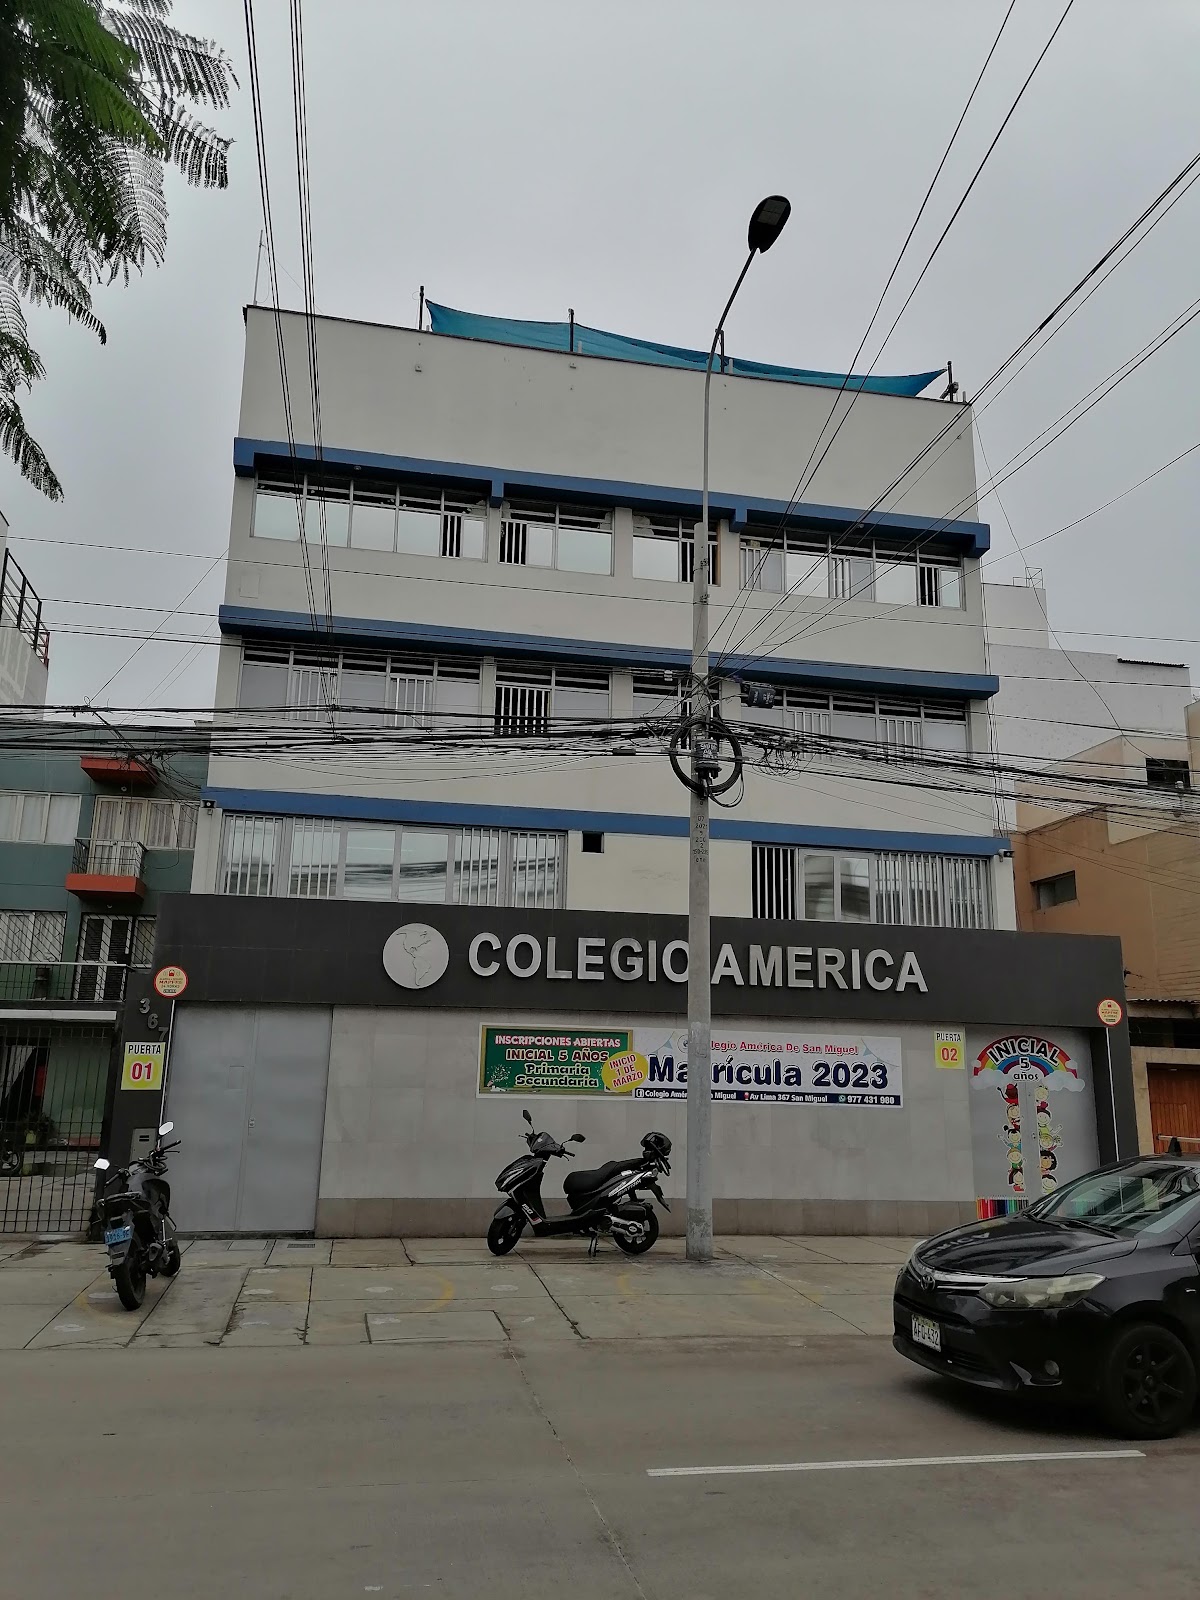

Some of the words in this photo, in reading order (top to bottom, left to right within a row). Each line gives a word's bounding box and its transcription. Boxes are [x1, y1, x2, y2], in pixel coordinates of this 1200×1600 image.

[468, 932, 690, 983] COLEGIO
[710, 943, 929, 992] AMERICA
[495, 1035, 572, 1046] INSCRIPCIONES
[573, 1036, 621, 1047] ABIERTAS
[937, 1033, 961, 1042] PUERTA
[128, 1044, 161, 1054] PUERTA
[711, 1041, 738, 1052] legio
[740, 1041, 783, 1053] América
[786, 1043, 800, 1053] De
[803, 1044, 822, 1054] San
[825, 1044, 859, 1056] Miguel
[941, 1048, 958, 1061] 02
[987, 1038, 1060, 1064] INICIAL
[506, 1049, 554, 1061] INICIAL
[558, 1050, 568, 1061] 5
[572, 1048, 609, 1062] AÑOS
[609, 1054, 636, 1069] INICIO
[1020, 1058, 1030, 1069] 5
[132, 1062, 152, 1080] 01
[525, 1062, 590, 1075] Primaria
[624, 1064, 636, 1075] DE
[648, 1055, 802, 1086] Marícula
[812, 1060, 888, 1089] 2023
[516, 1075, 598, 1087] Secundaria
[613, 1071, 643, 1088] MARZO
[1013, 1072, 1039, 1080] años
[645, 1090, 669, 1099] Colegio
[715, 1092, 737, 1100] Miguel
[805, 1095, 828, 1103] Miguel
[847, 1095, 862, 1103] 977
[863, 1096, 878, 1104] 431
